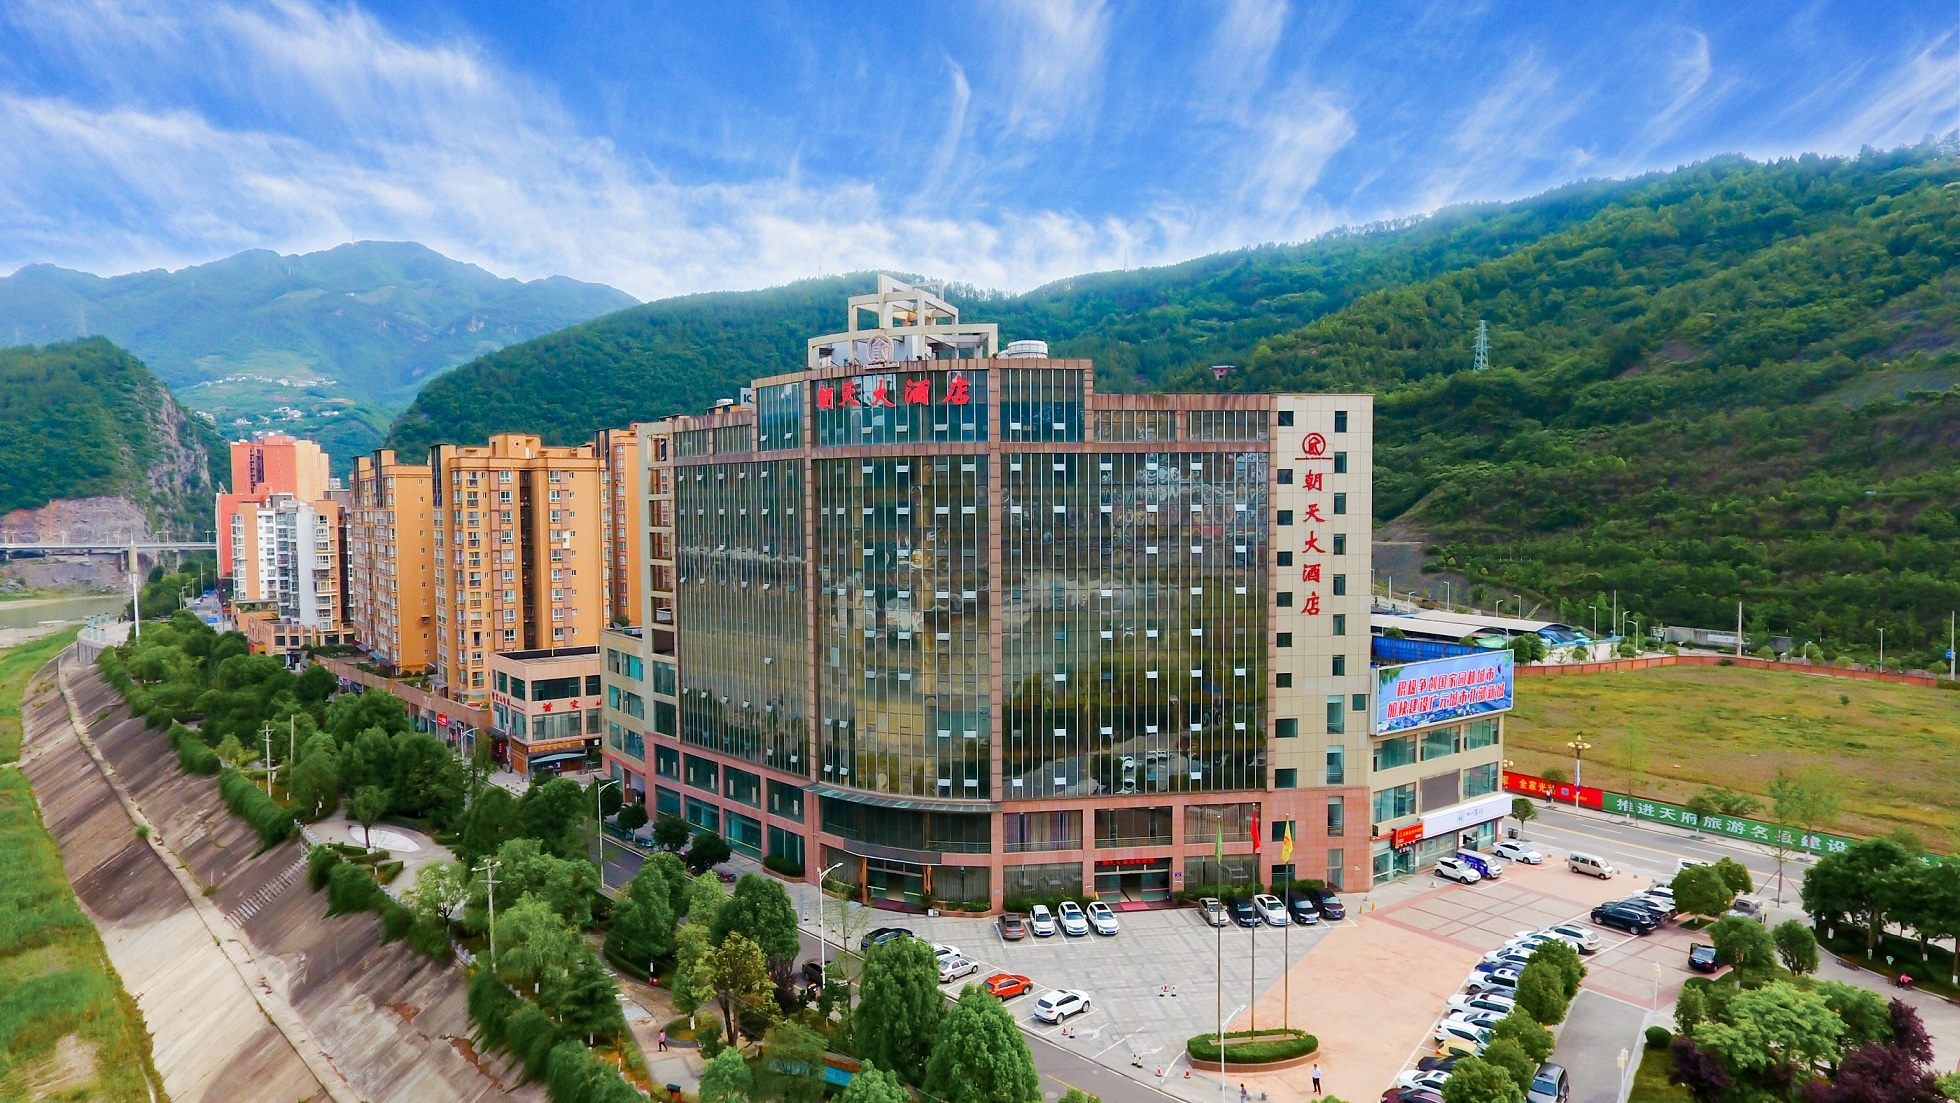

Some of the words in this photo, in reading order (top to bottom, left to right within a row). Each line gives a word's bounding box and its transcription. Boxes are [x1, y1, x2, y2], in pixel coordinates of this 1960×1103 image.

[816, 374, 971, 410] 朝天大酒店
[1301, 469, 1326, 616] 朝天大酒店
[1386, 681, 1506, 719] 加快建设广元城市北部新城
[1396, 666, 1496, 697] 积极争创国家园林城市
